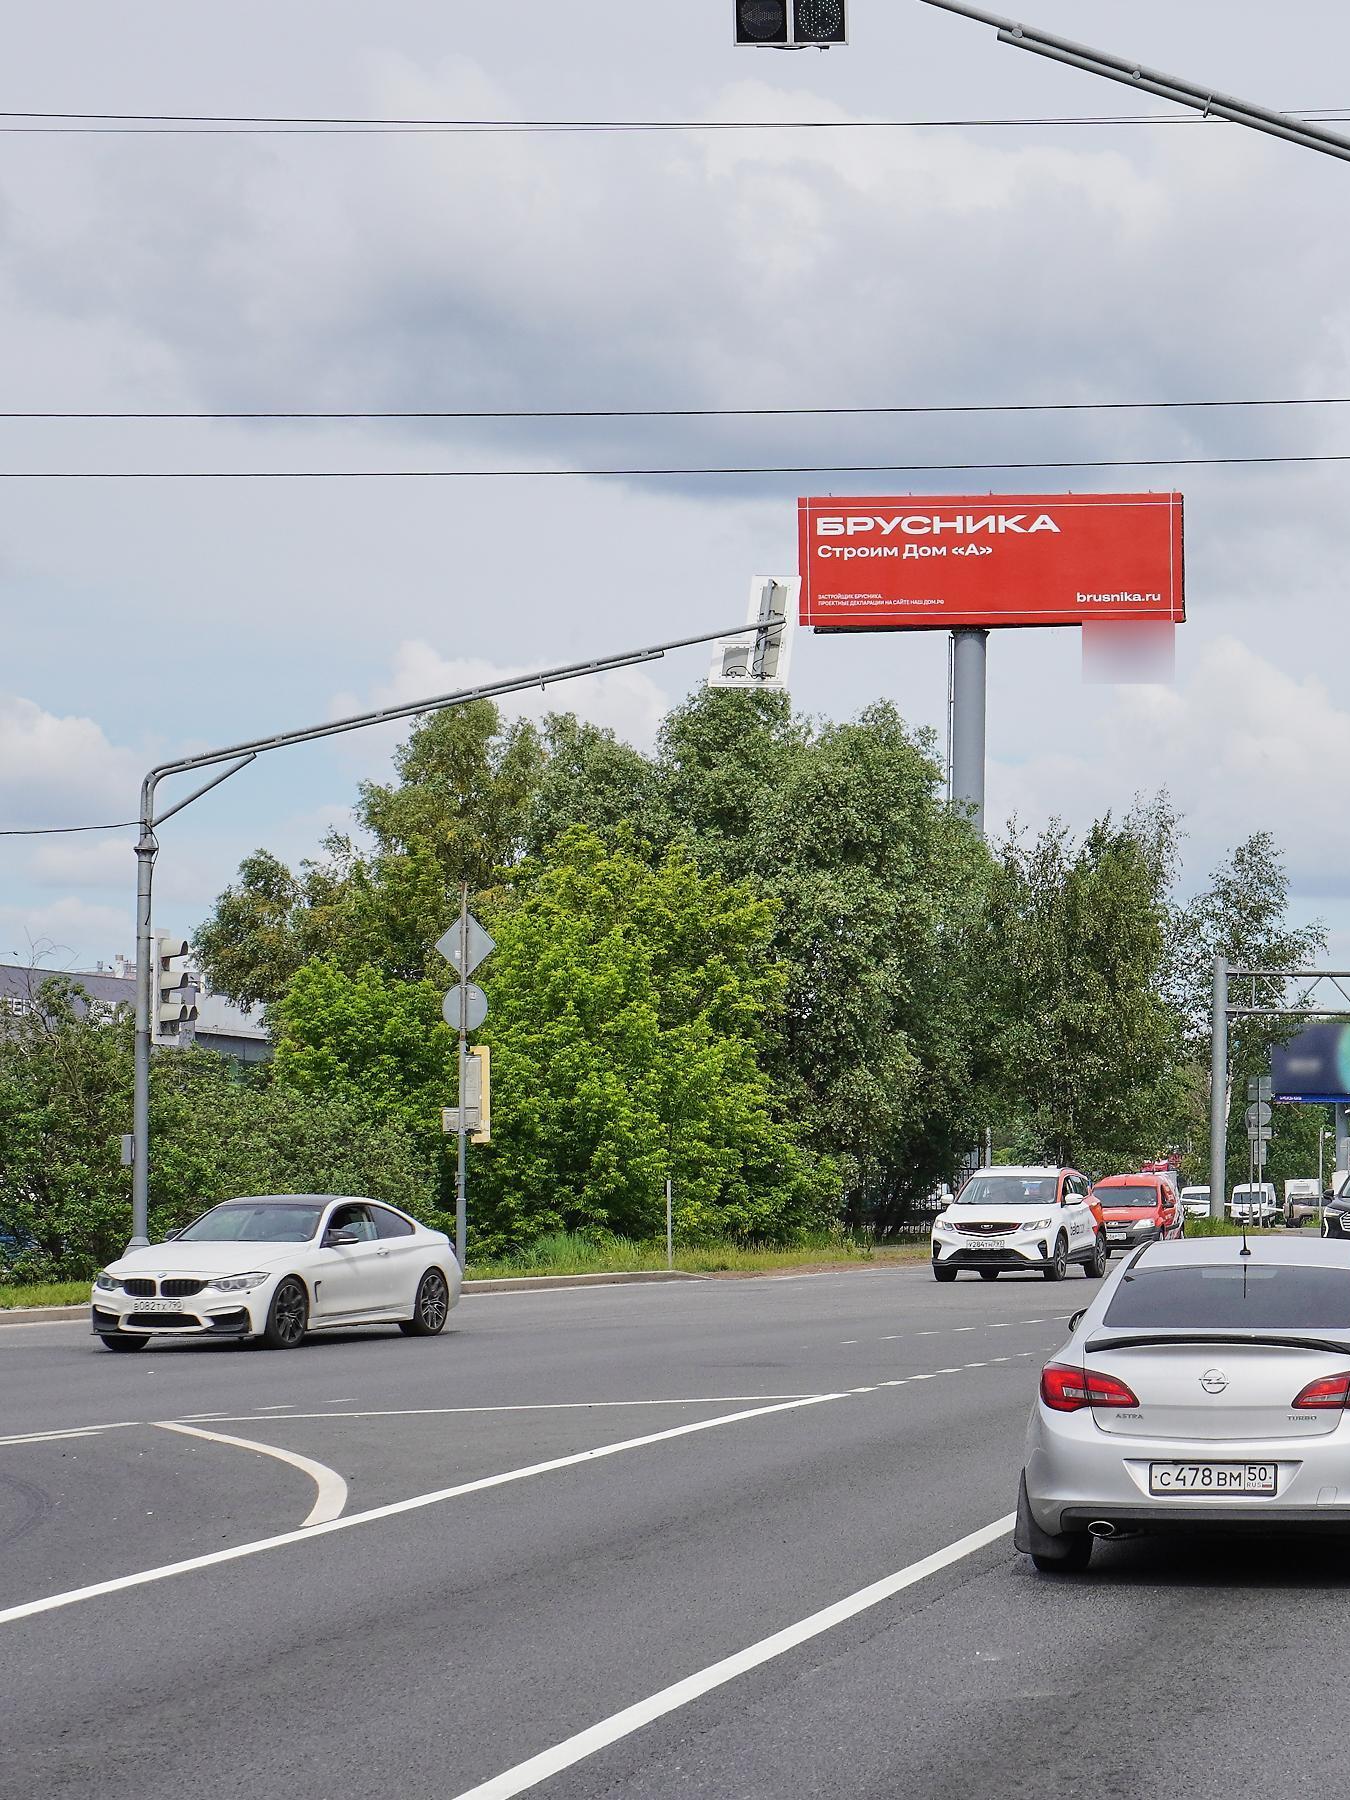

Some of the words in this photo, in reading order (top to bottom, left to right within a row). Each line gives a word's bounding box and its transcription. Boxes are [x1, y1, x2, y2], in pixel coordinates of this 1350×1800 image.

[816, 513, 1061, 536] БРУСНИКА
[817, 545, 898, 560] Строим
[902, 544, 947, 559] Дом
[952, 543, 993, 556] «А»
[1076, 591, 1161, 602] brusnika.ru
